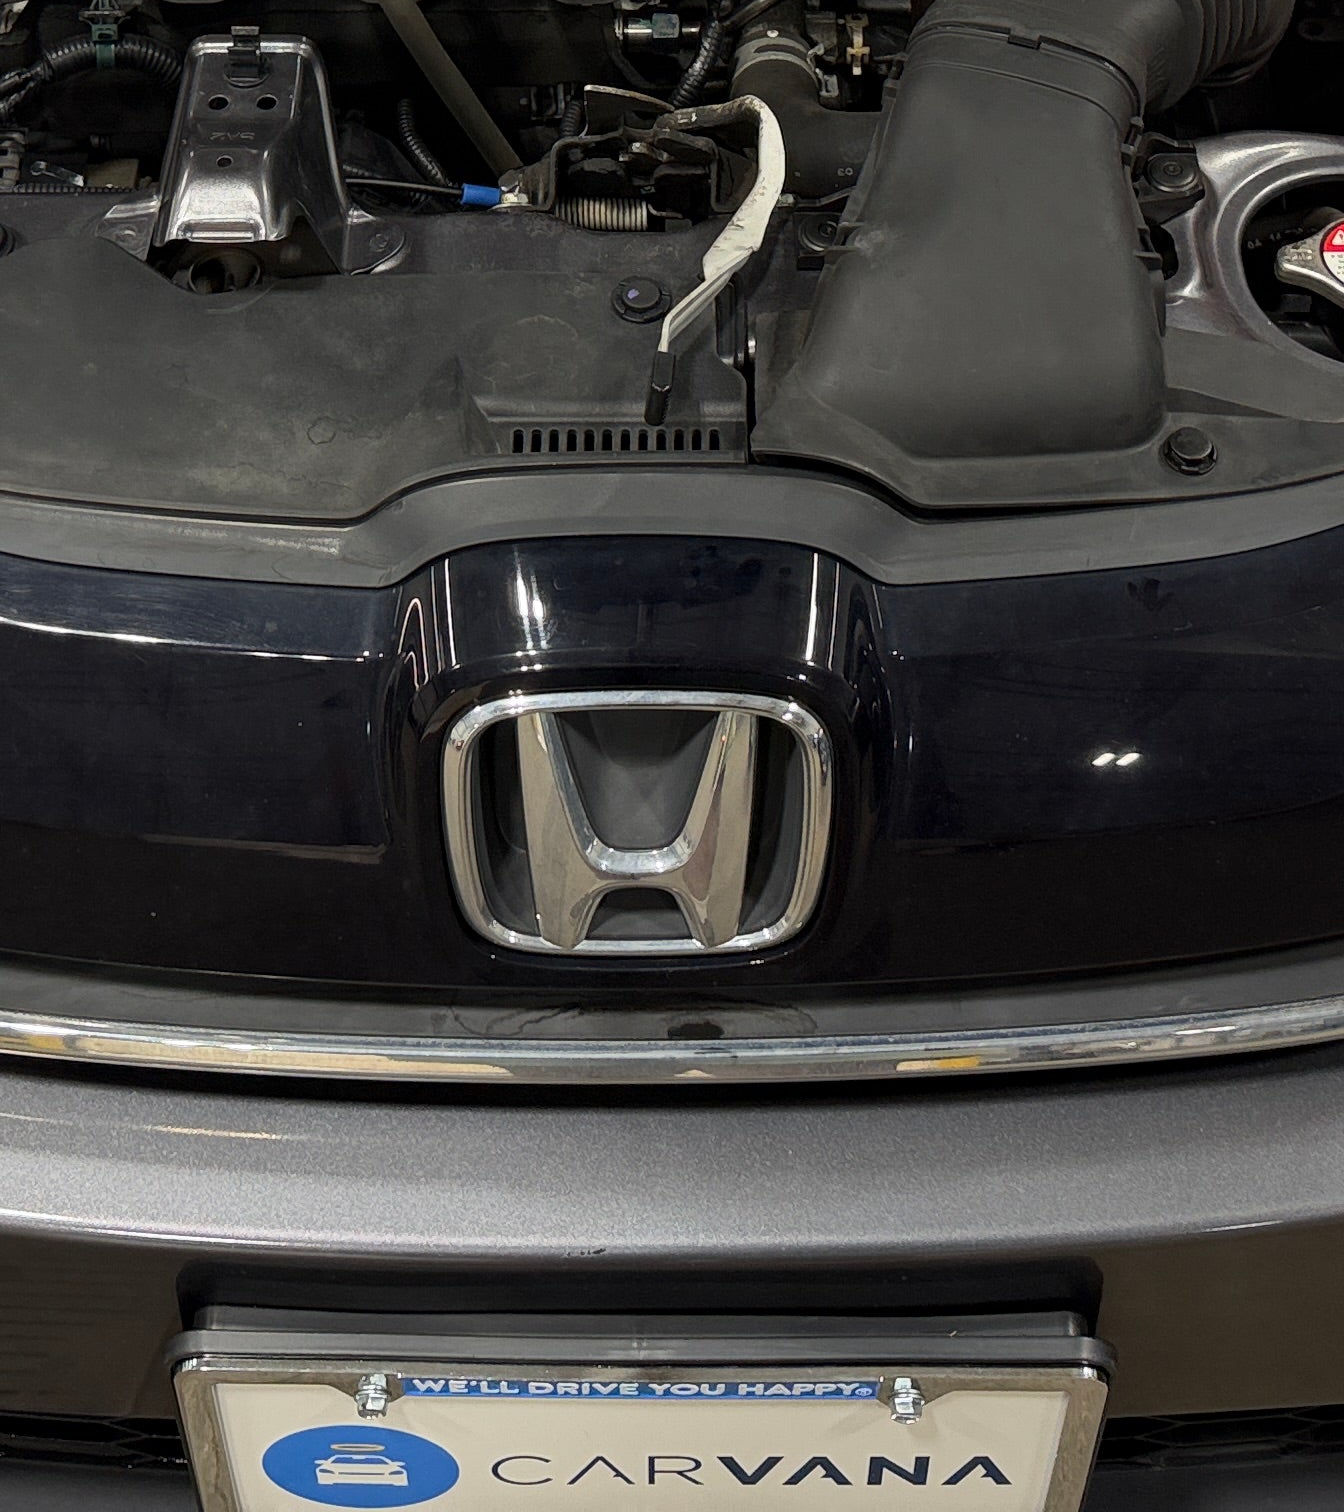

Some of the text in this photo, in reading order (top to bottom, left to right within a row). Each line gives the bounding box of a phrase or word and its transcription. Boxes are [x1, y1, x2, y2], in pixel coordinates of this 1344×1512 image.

[412, 1378, 520, 1395] WE'LL
[527, 1381, 640, 1396] DRIVE
[647, 1382, 726, 1396] YOU
[490, 1454, 1013, 1486] CARVANA
